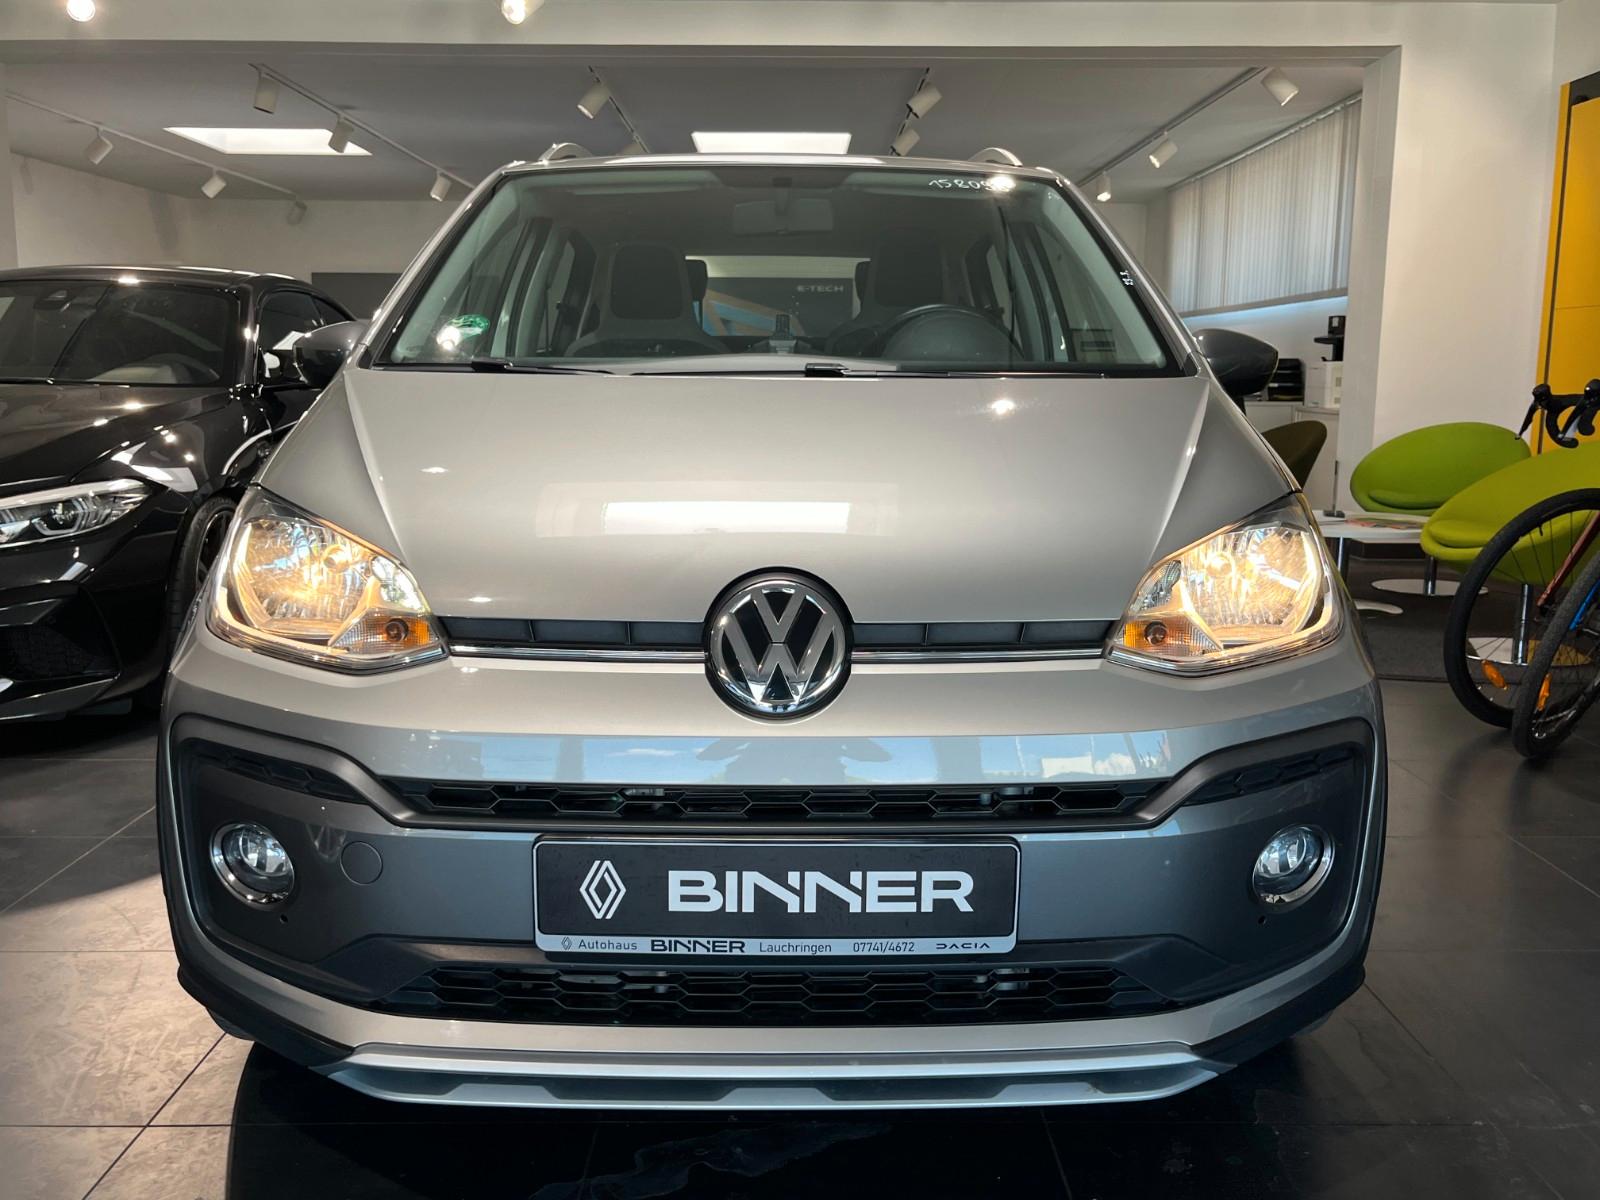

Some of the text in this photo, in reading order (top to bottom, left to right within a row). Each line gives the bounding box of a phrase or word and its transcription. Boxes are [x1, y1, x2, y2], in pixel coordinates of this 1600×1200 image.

[667, 869, 975, 914] BINNER
[578, 938, 991, 956] Autohaus BINNER Lauchringen 07741/4672 DACIA
